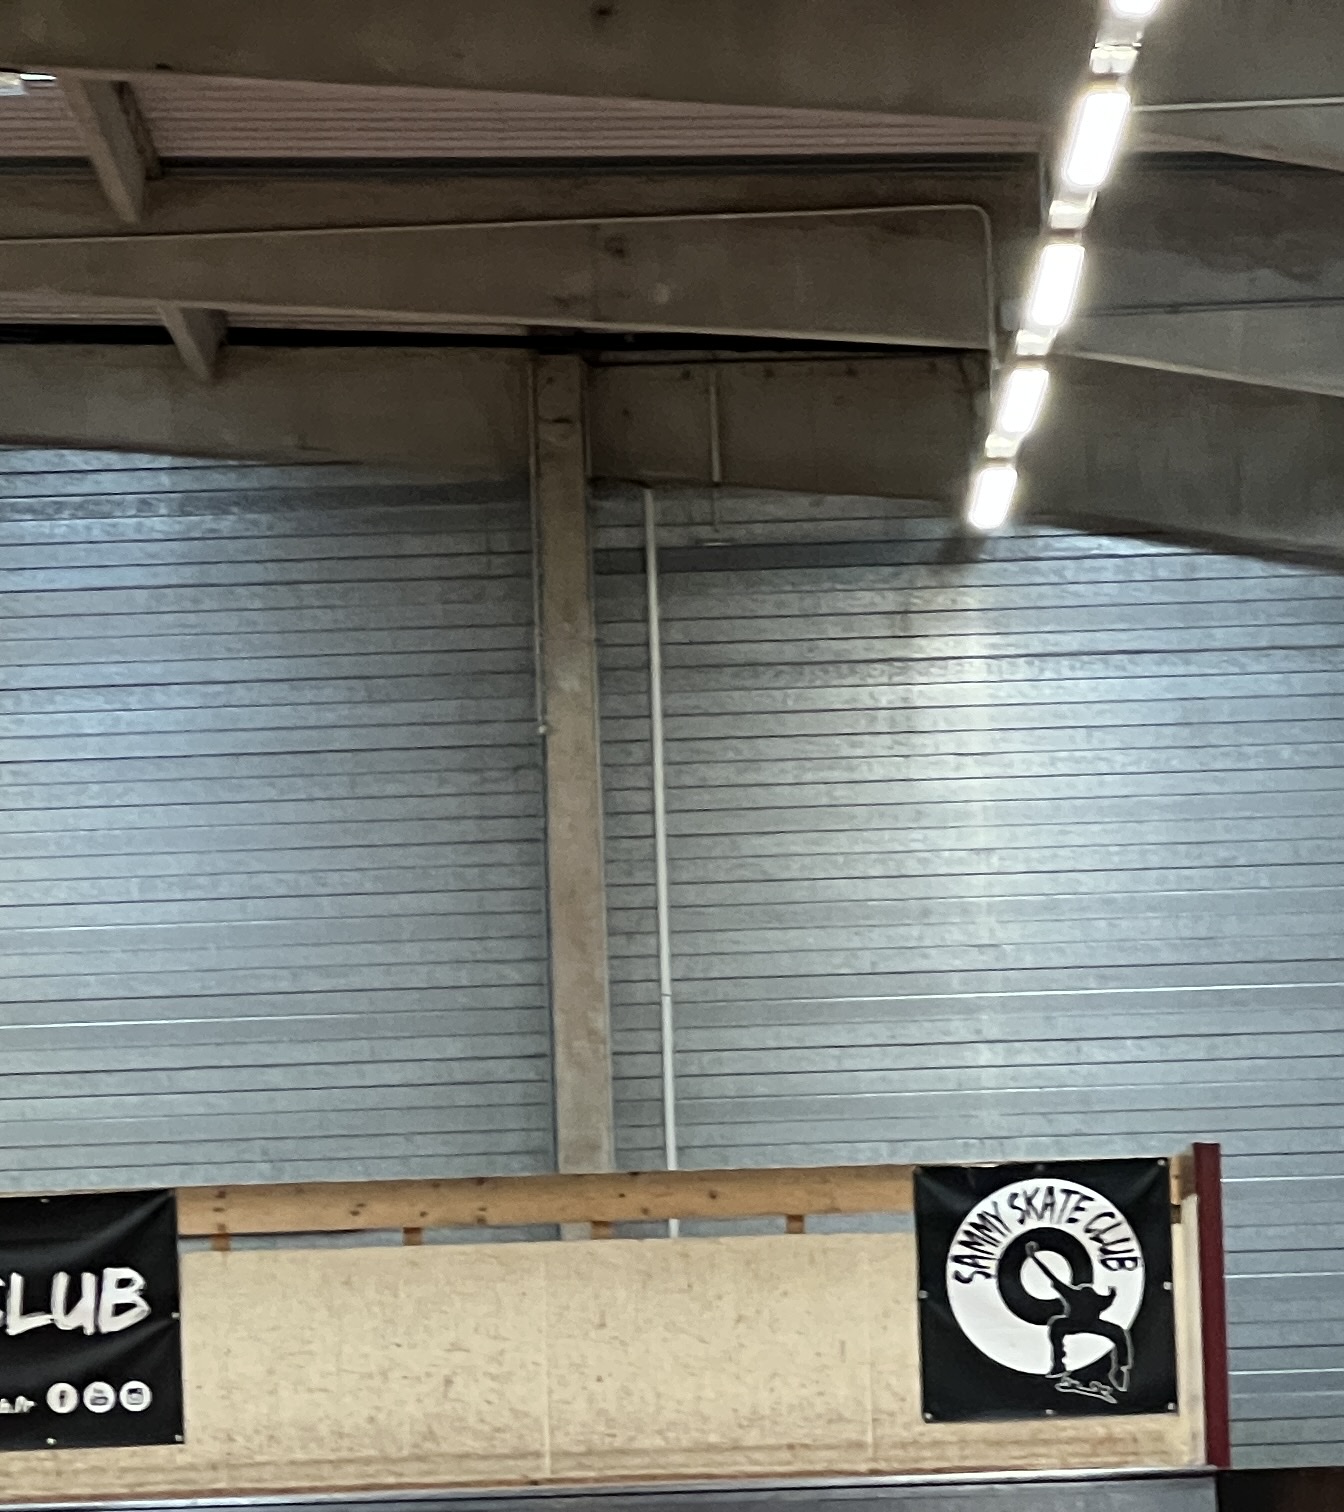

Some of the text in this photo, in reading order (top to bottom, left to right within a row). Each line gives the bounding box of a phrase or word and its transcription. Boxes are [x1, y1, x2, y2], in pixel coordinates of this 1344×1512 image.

[952, 1185, 1140, 1284] SAMMY SKATE CLUB
